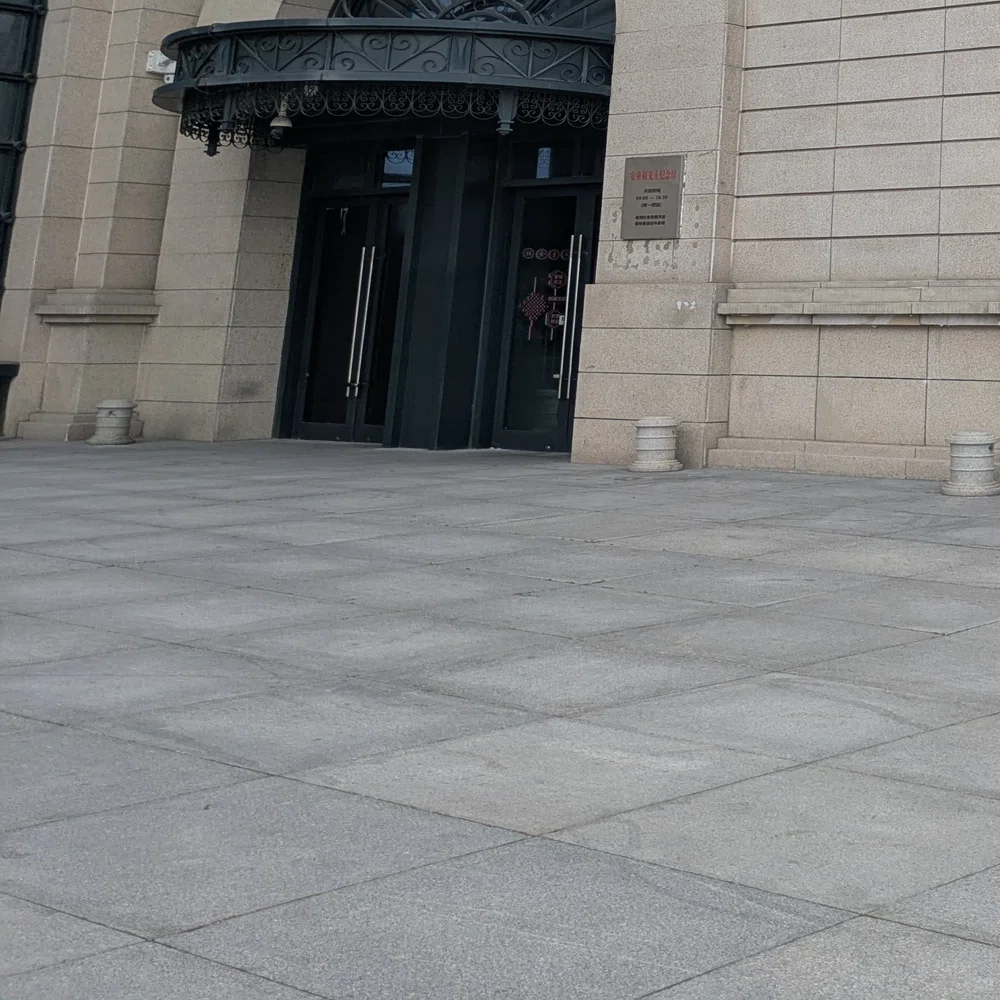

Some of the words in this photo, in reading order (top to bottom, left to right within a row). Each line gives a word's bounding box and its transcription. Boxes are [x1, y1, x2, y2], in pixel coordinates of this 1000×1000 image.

[630, 169, 677, 181] 安重根义士纪念馆
